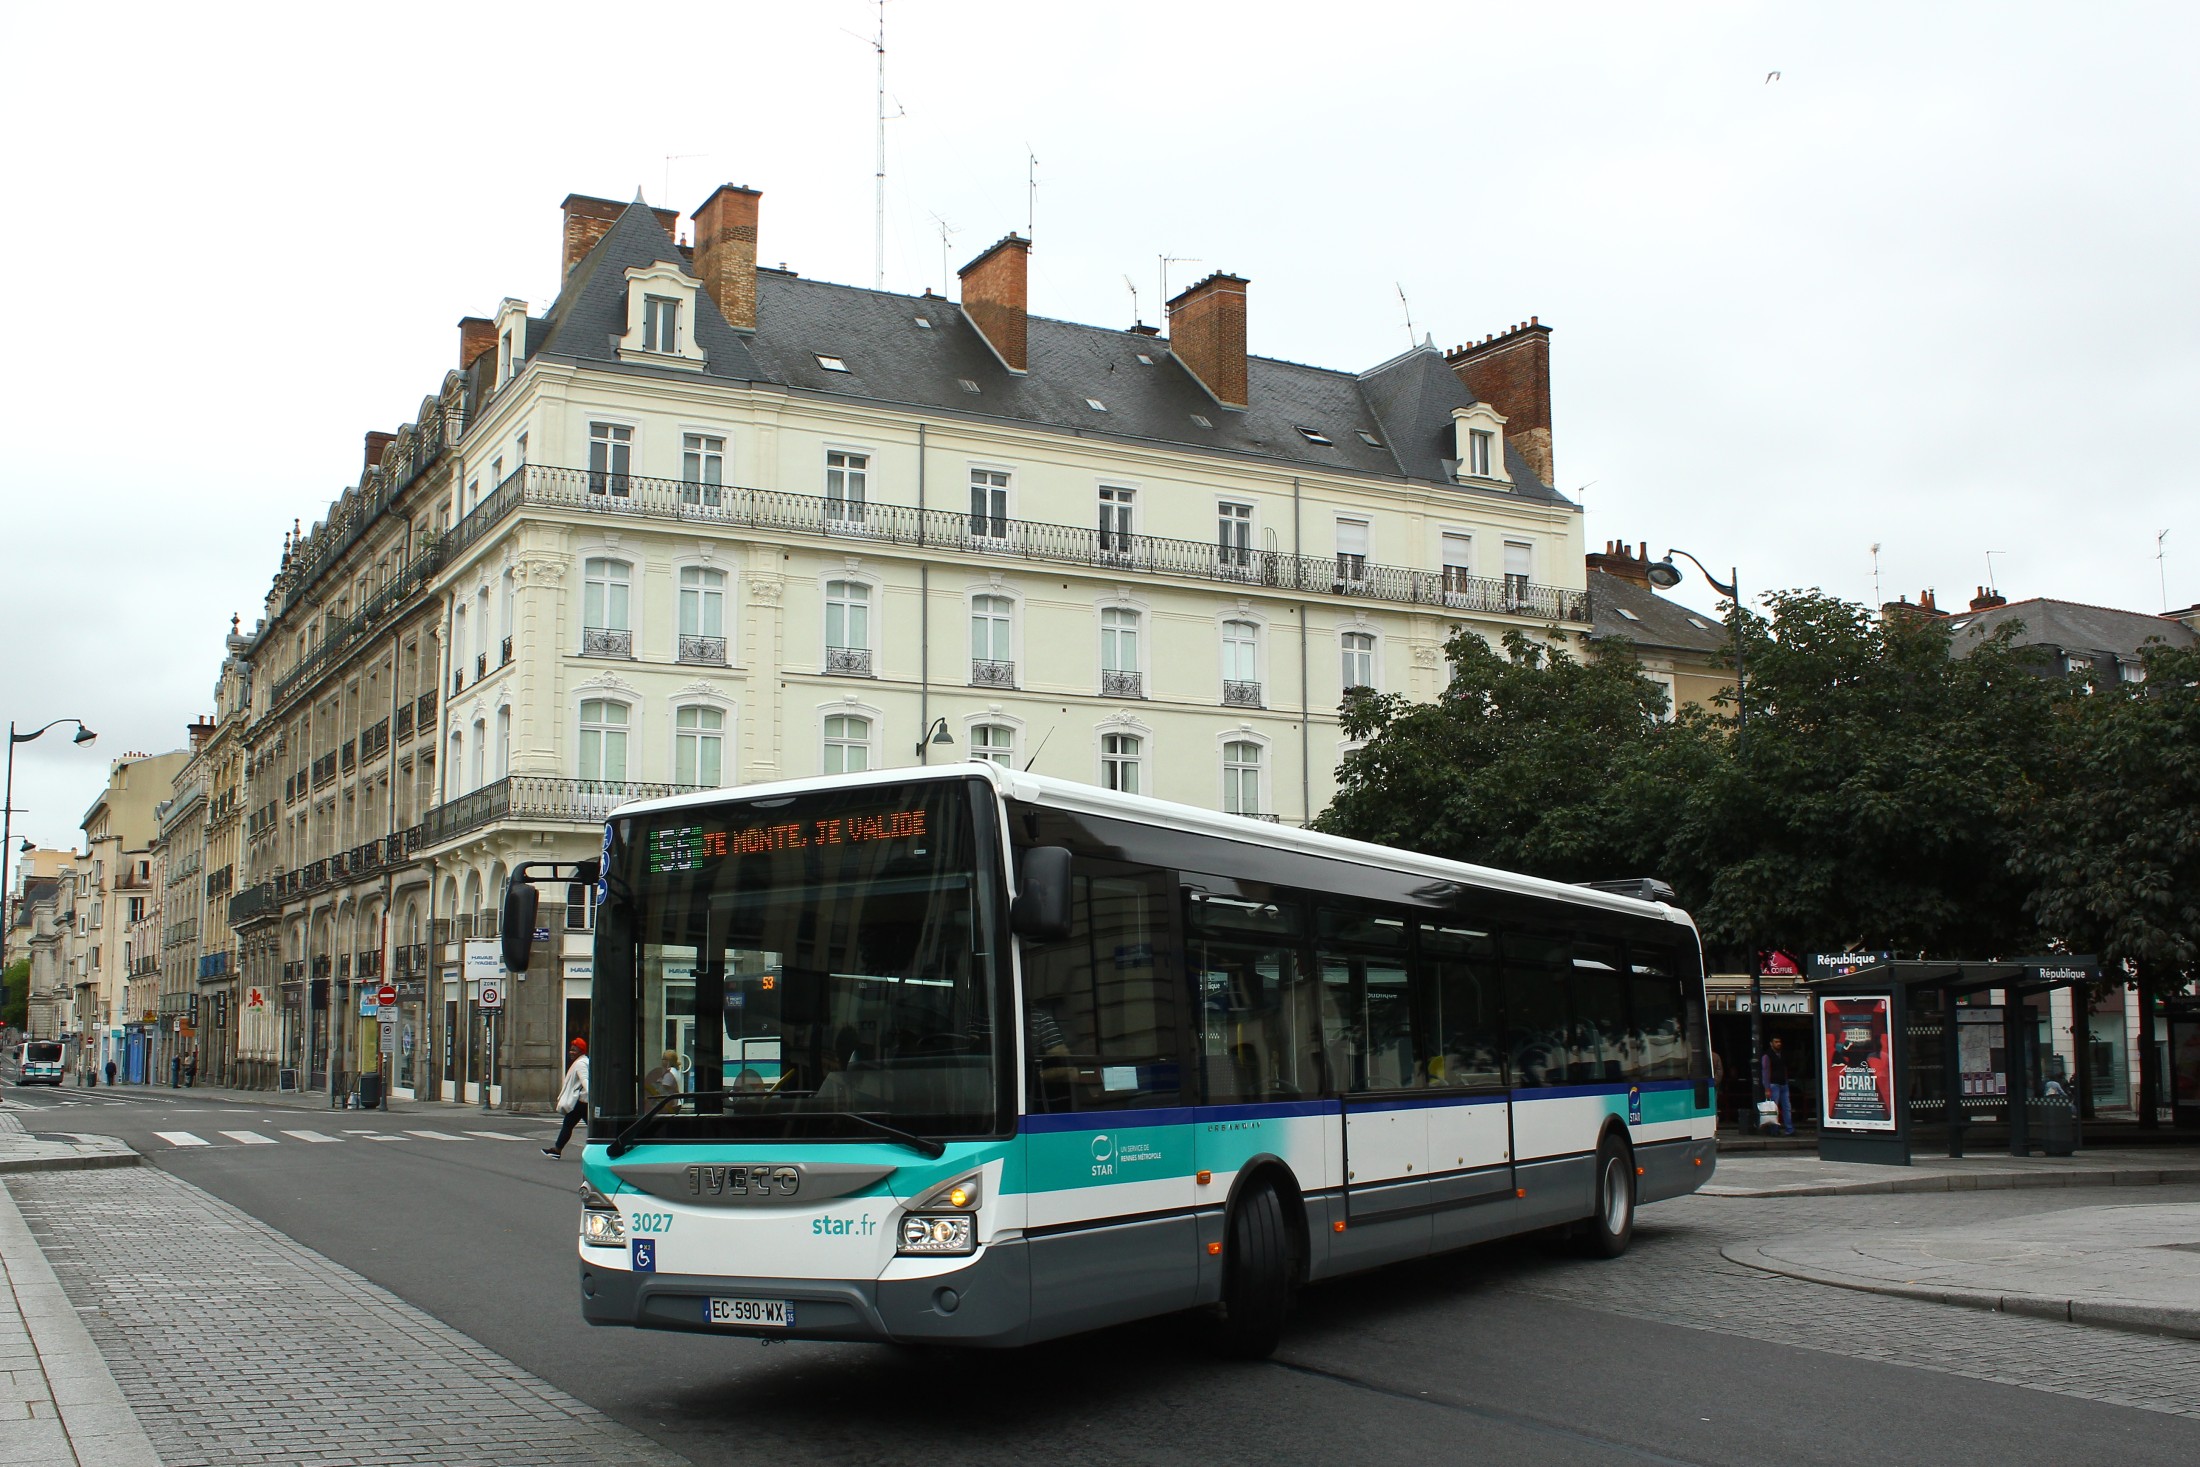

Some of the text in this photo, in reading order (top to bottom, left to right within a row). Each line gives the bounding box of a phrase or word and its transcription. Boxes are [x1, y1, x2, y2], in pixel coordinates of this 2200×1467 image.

[702, 832, 727, 857] JE
[815, 819, 841, 845] JE
[848, 810, 926, 841] VALIDE
[1817, 952, 1876, 968] République
[1771, 966, 1793, 974] COIFFURE
[2039, 967, 2086, 980] République
[762, 976, 774, 989] 53
[1629, 1112, 1641, 1122] STAR
[1091, 1164, 1113, 1176] STAR
[689, 1166, 800, 1197] IVECO
[631, 1212, 674, 1233] 3027
[812, 1213, 877, 1235] star.fr
[712, 1300, 784, 1322] EC-590-WX
[786, 1313, 794, 1322] 35
